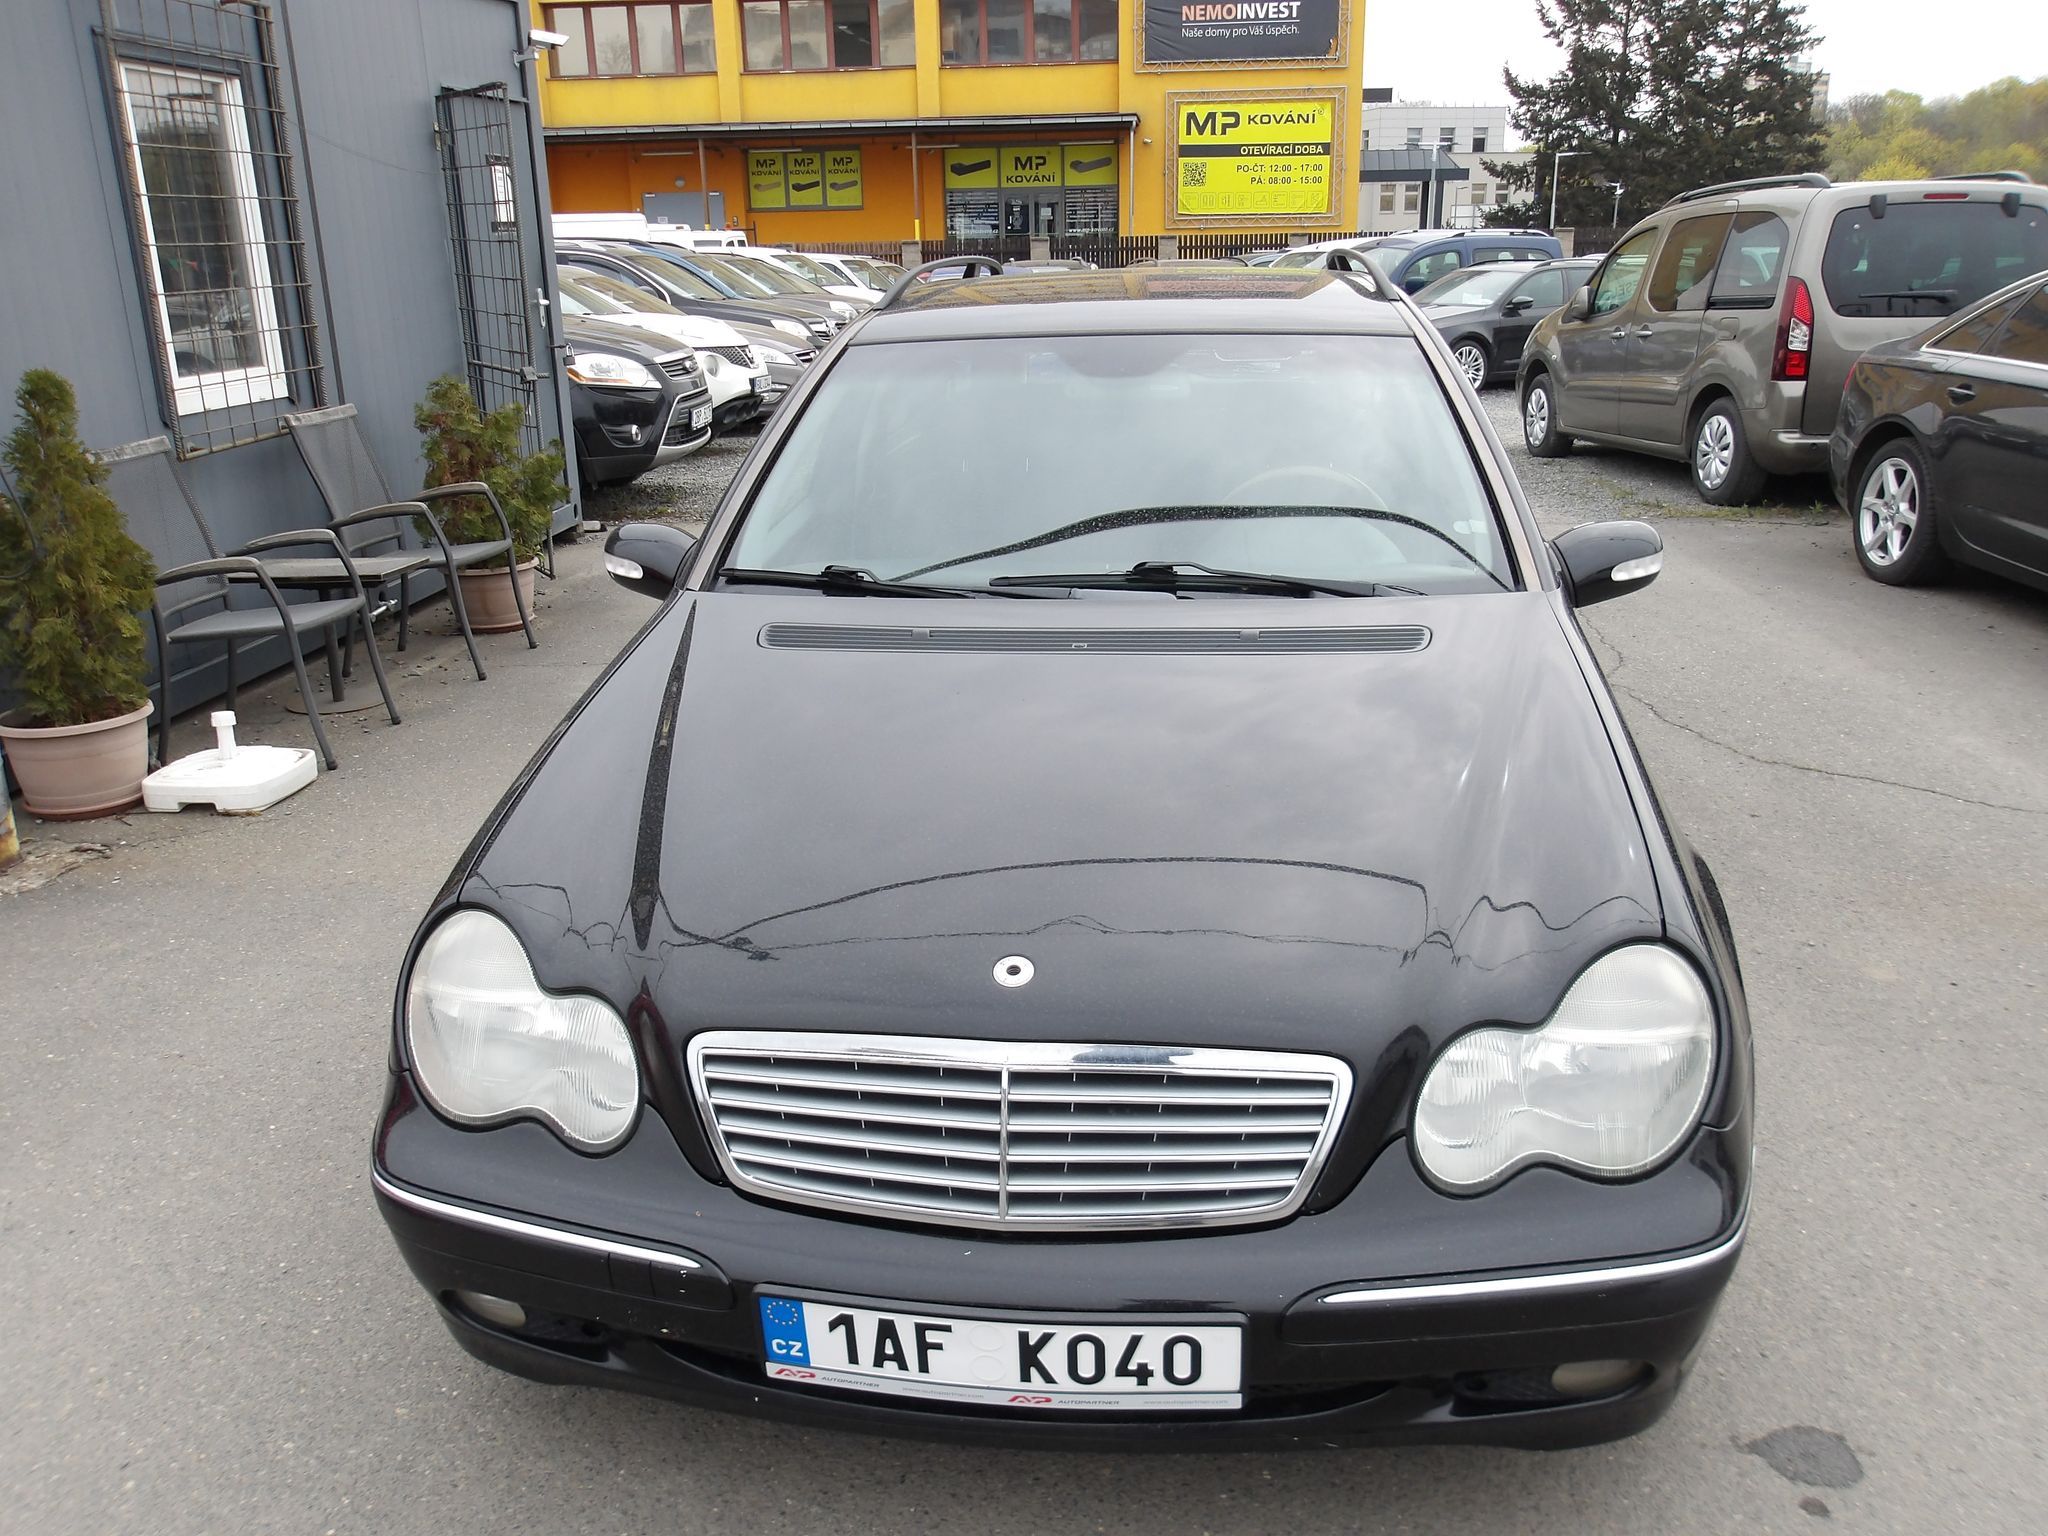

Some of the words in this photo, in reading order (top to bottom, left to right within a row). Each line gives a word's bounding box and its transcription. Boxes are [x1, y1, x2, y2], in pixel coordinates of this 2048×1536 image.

[1181, 1, 1301, 21] NEMOINVEST
[1181, 27, 1203, 38] Naše
[1205, 26, 1230, 38] domy
[1232, 27, 1248, 37] pro
[1249, 25, 1264, 36] Váš
[1265, 24, 1300, 36] úspěch.
[1185, 111, 1241, 136] MP
[1247, 110, 1316, 125] KOVÁNÍ
[1240, 143, 1293, 155] OTEVÍRACÍ
[1296, 144, 1324, 155] DOBA
[755, 158, 776, 169] MP
[793, 157, 814, 168] MP
[832, 156, 853, 167] MP
[1014, 155, 1048, 171] MP
[1236, 163, 1266, 173] PO-ČT:
[1269, 164, 1292, 173] 12:00
[1300, 163, 1323, 172] 17:00
[1006, 172, 1056, 184] KOVÁNÍ
[1250, 175, 1266, 185] PÁ:
[1268, 176, 1292, 185] 08:00
[1300, 175, 1323, 184] 15:00
[771, 1338, 804, 1357] CZ
[827, 1311, 953, 1374] 1AF
[821, 1375, 881, 1389] AUTOPARTNER
